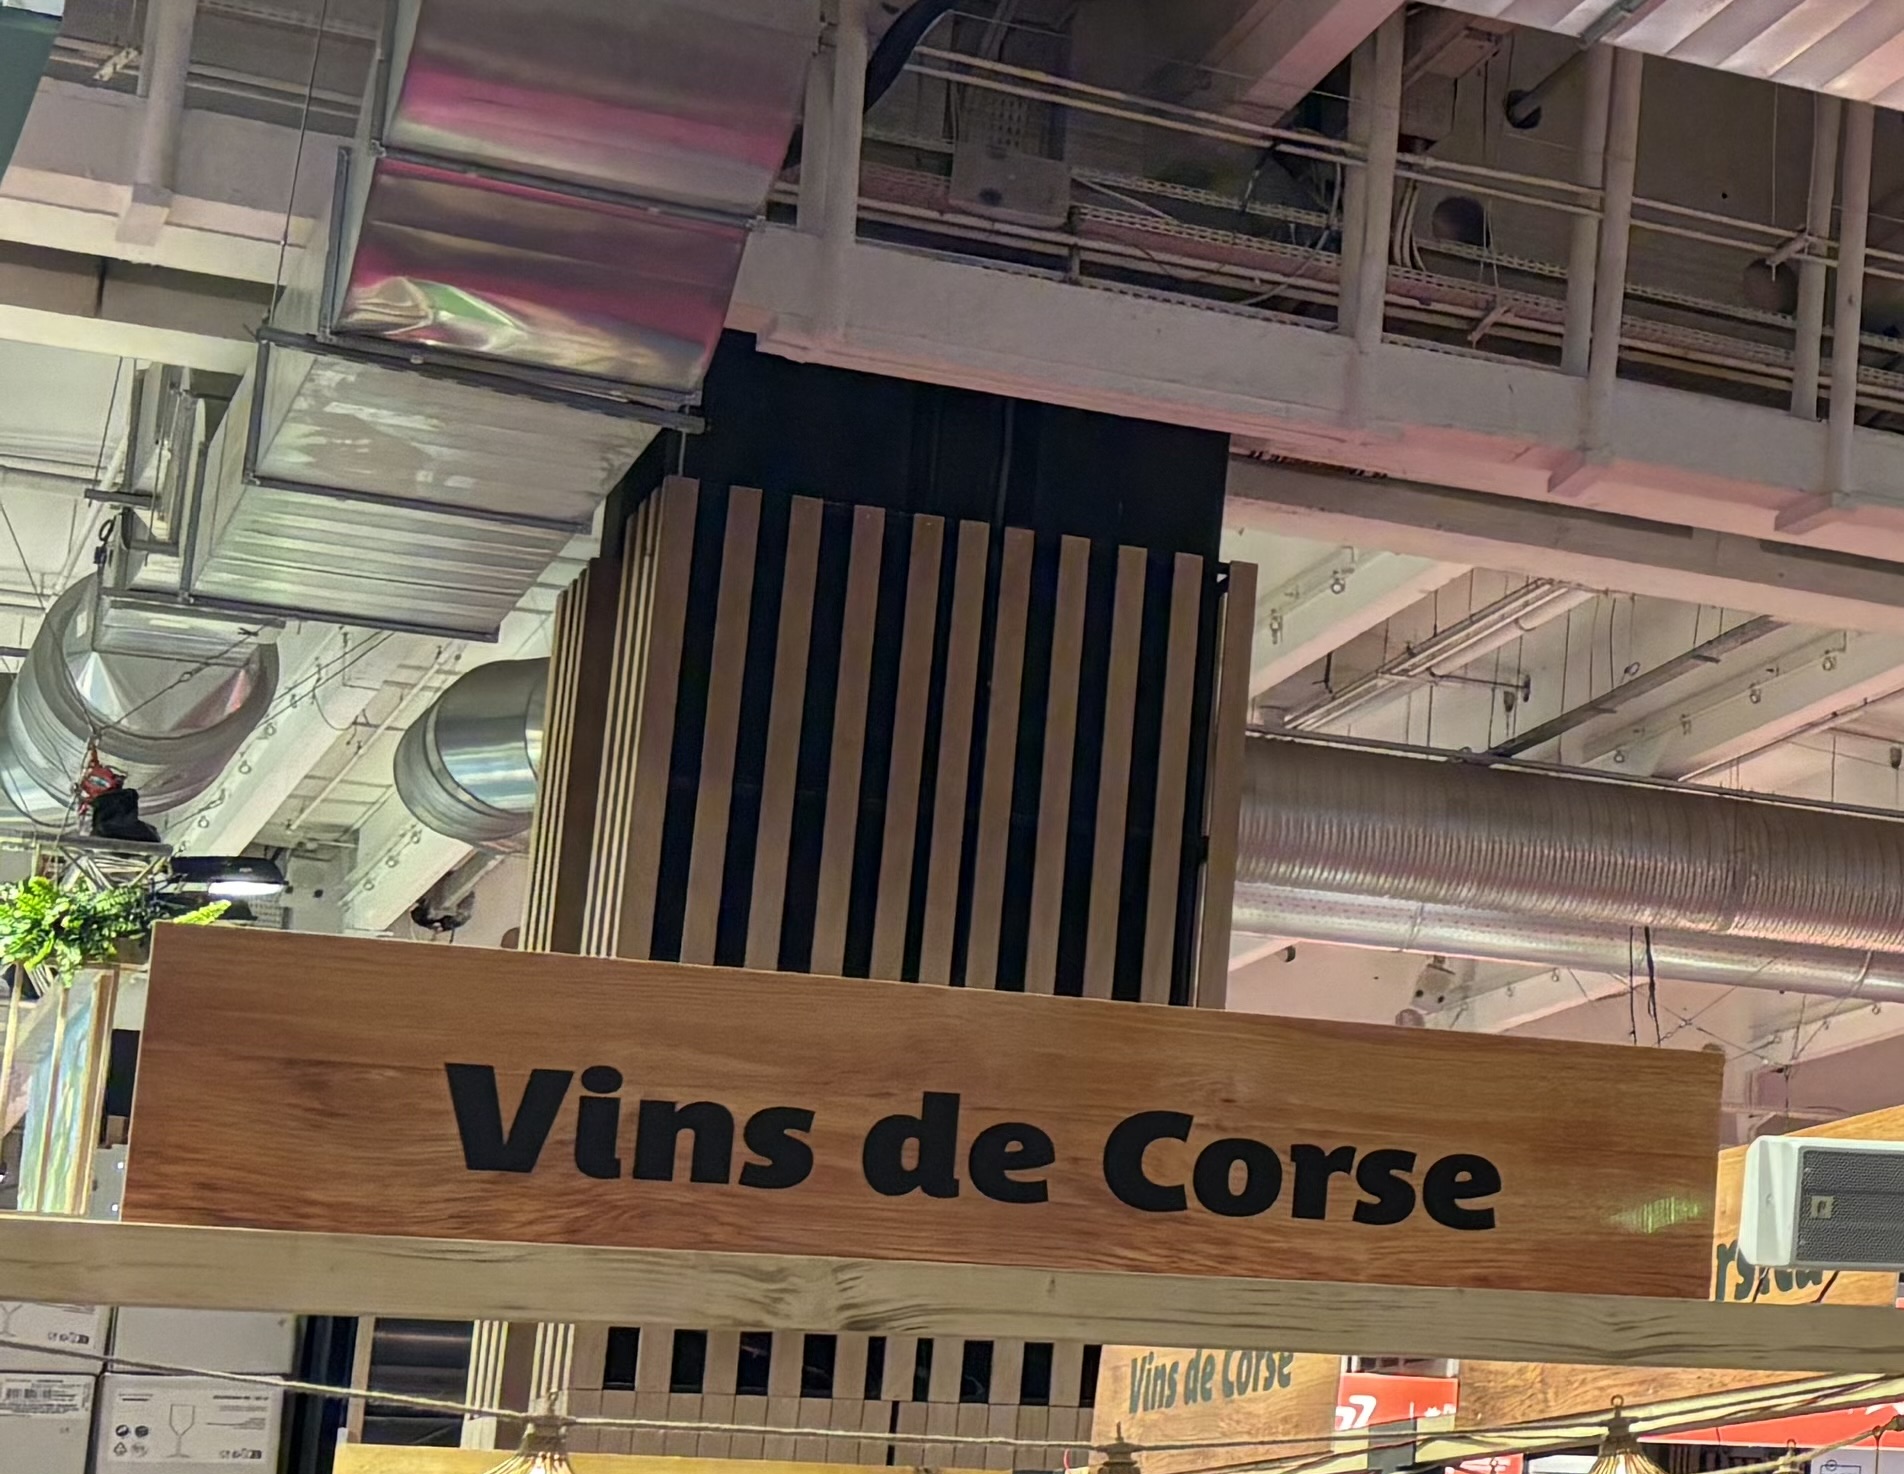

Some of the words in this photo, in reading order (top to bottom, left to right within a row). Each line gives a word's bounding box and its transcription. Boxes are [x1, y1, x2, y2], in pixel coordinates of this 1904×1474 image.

[445, 1061, 815, 1190] Vins
[862, 1090, 1056, 1203] de
[1103, 1110, 1502, 1231] Corse
[1129, 1351, 1180, 1414] Vins
[1184, 1349, 1216, 1406] de
[1222, 1350, 1294, 1398] Corse
